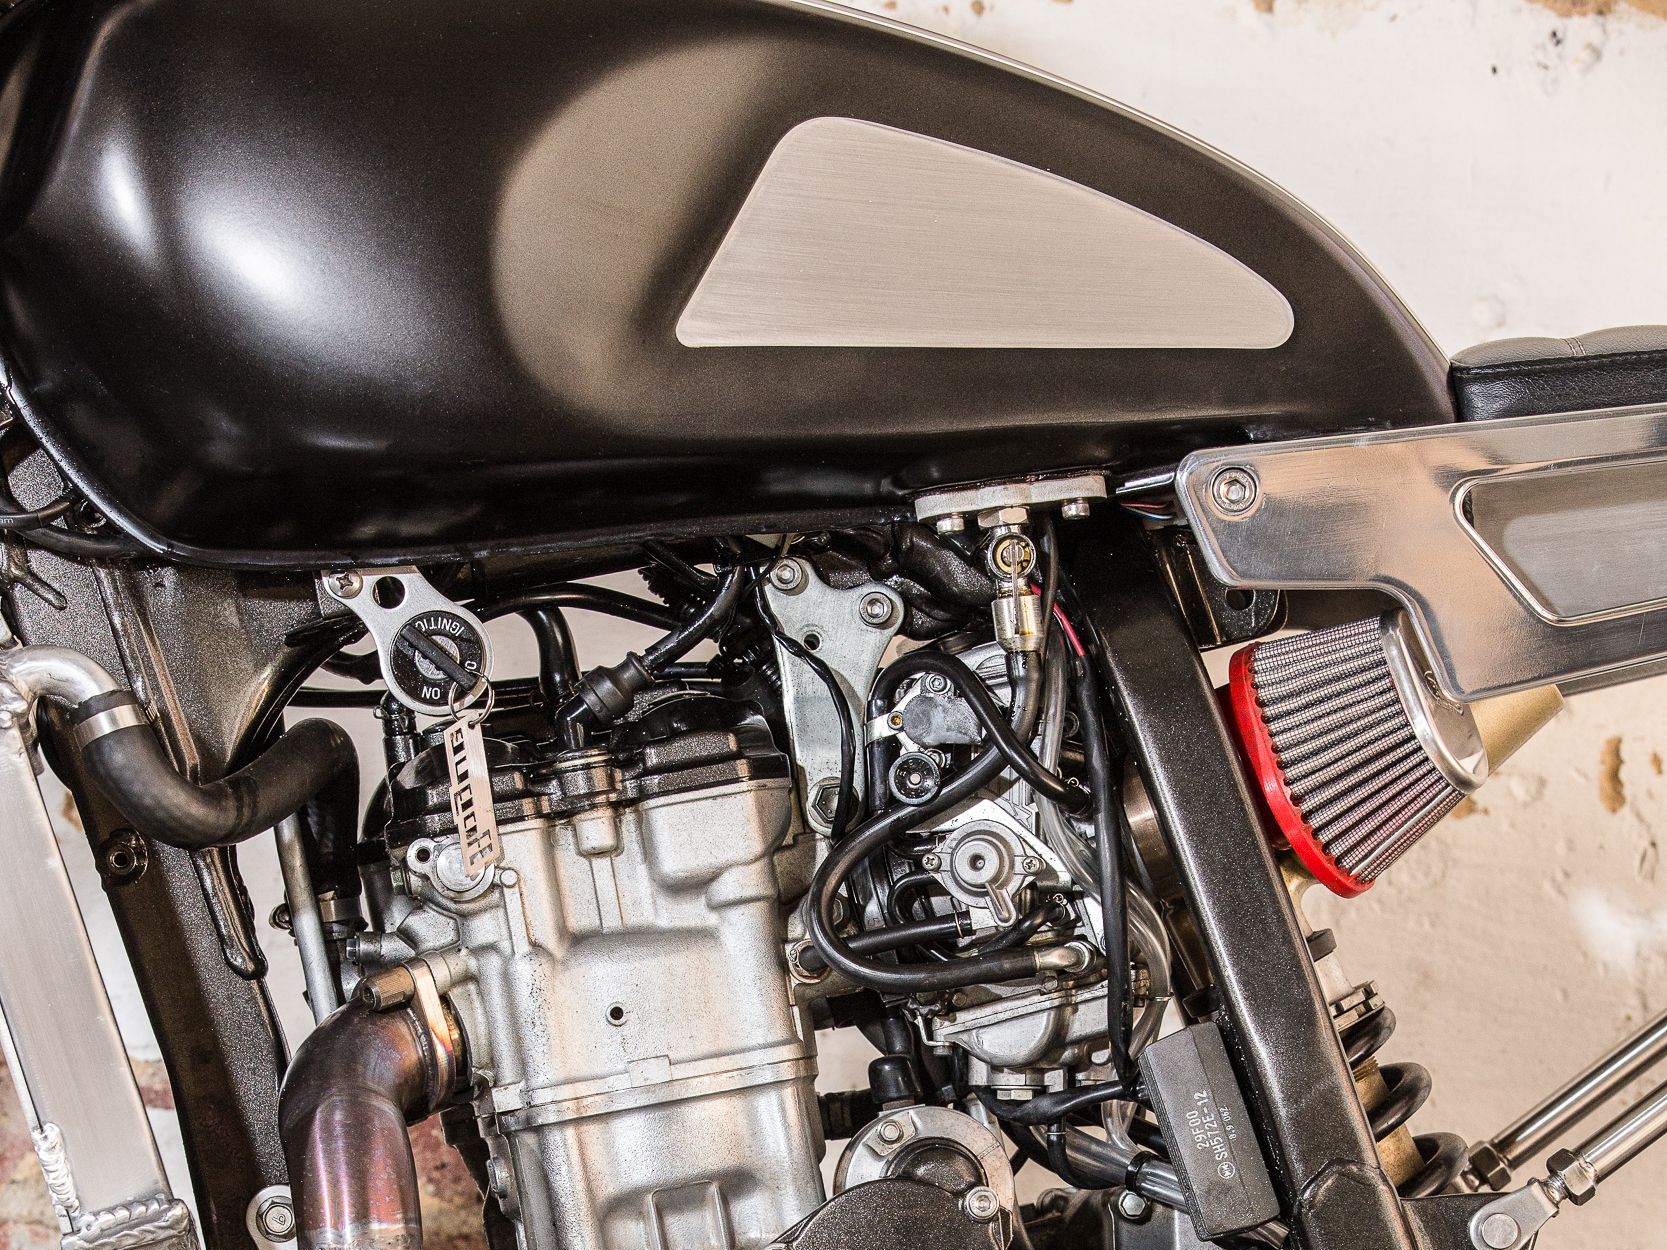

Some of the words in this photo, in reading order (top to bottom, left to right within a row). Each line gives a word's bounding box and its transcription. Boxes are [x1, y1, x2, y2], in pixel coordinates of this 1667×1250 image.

[421, 686, 441, 700] ON
[1186, 1111, 1209, 1149] 29F00
[1194, 1090, 1228, 1160] SH572E-12
